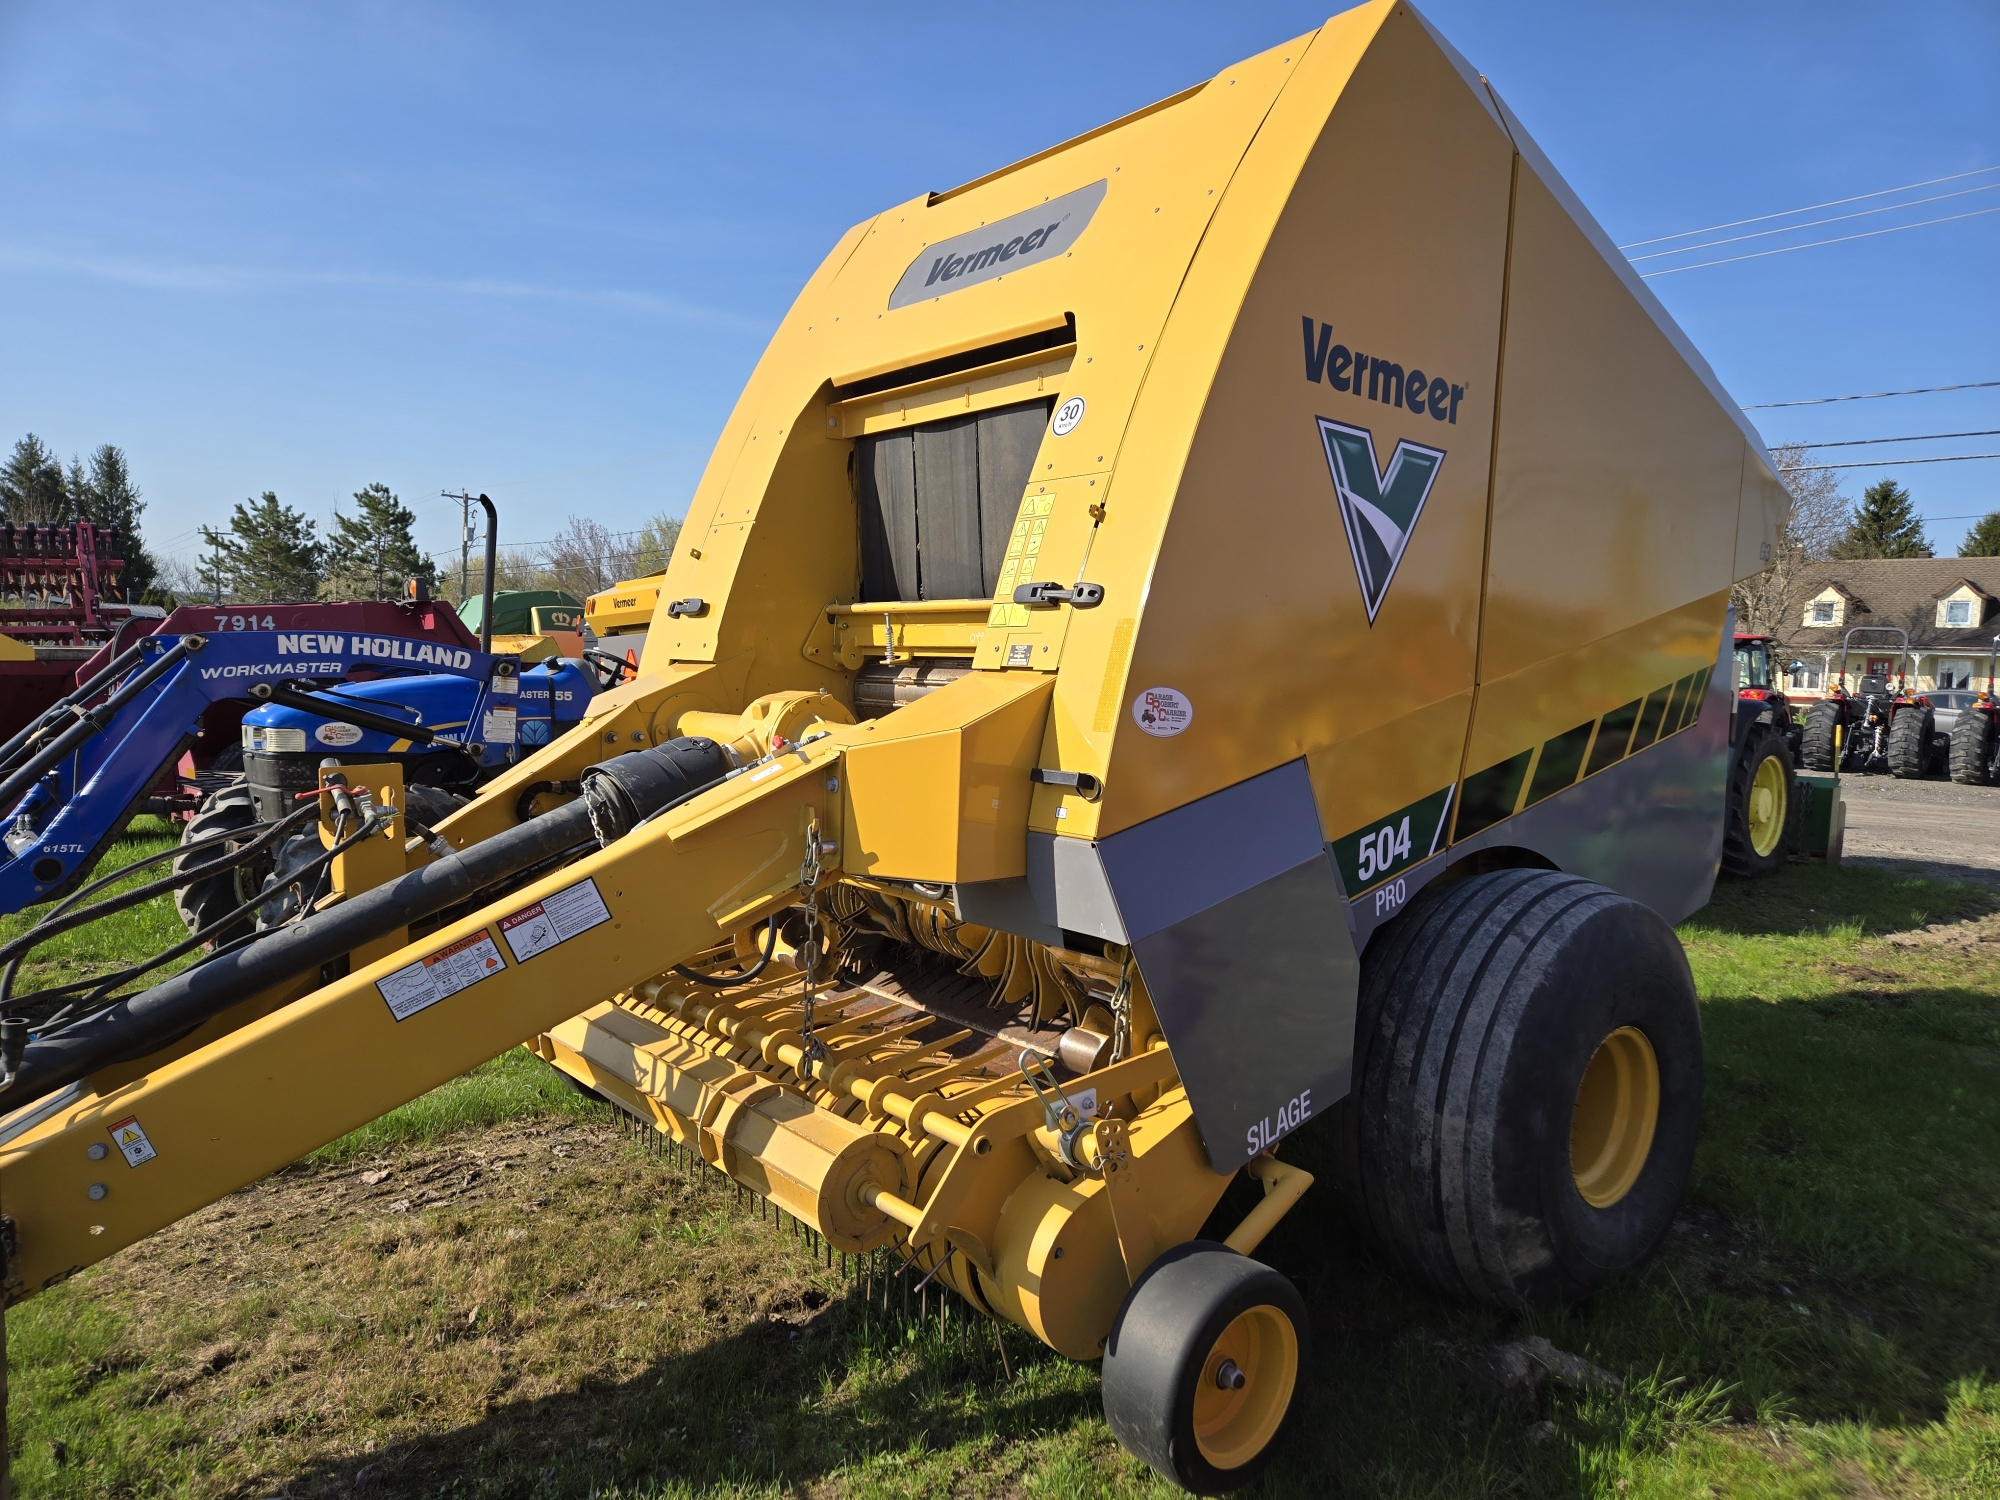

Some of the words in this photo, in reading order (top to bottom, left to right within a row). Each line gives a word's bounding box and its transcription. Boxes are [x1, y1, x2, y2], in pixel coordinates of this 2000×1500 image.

[924, 221, 1061, 288] Vermeer
[1302, 315, 1464, 425] Vermeer
[1060, 404, 1080, 421] 30
[613, 597, 637, 609] Vermeer
[214, 615, 276, 631] 7914
[277, 634, 344, 655] NEW
[351, 636, 472, 670] HOLLAND
[200, 662, 342, 680] WORKMASTER
[519, 690, 550, 699] ASTER
[554, 691, 573, 701] 55
[43, 844, 85, 853] 615TL
[1358, 815, 1411, 881] 504
[1376, 878, 1406, 917] PRO
[511, 905, 542, 925] DANGER
[438, 934, 482, 958] WARNING
[1246, 1088, 1312, 1156] SILAGE
